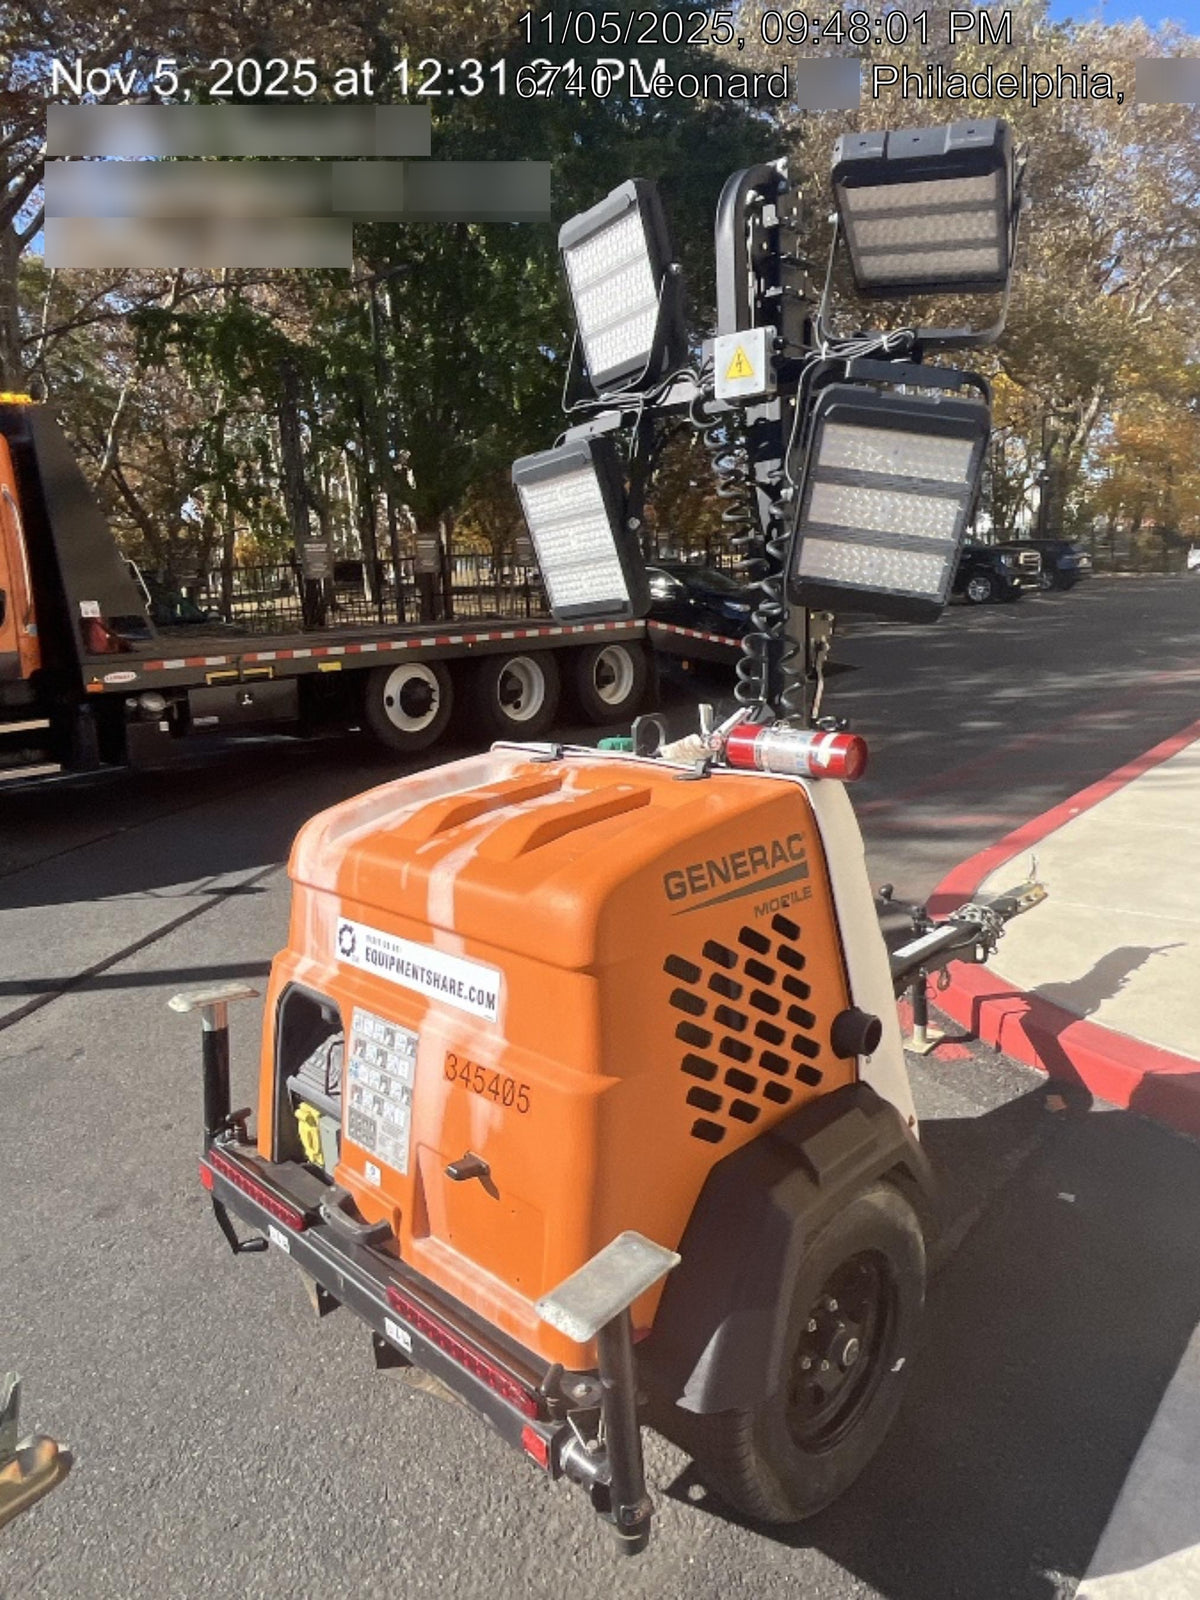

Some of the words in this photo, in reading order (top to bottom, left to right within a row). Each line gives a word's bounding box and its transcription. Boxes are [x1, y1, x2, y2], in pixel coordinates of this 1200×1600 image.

[663, 832, 806, 901] GENERAC
[754, 884, 813, 918] MOBILE
[364, 946, 497, 1011] EQUIPMENTSHARE.COM
[445, 1053, 531, 1114] 345405
